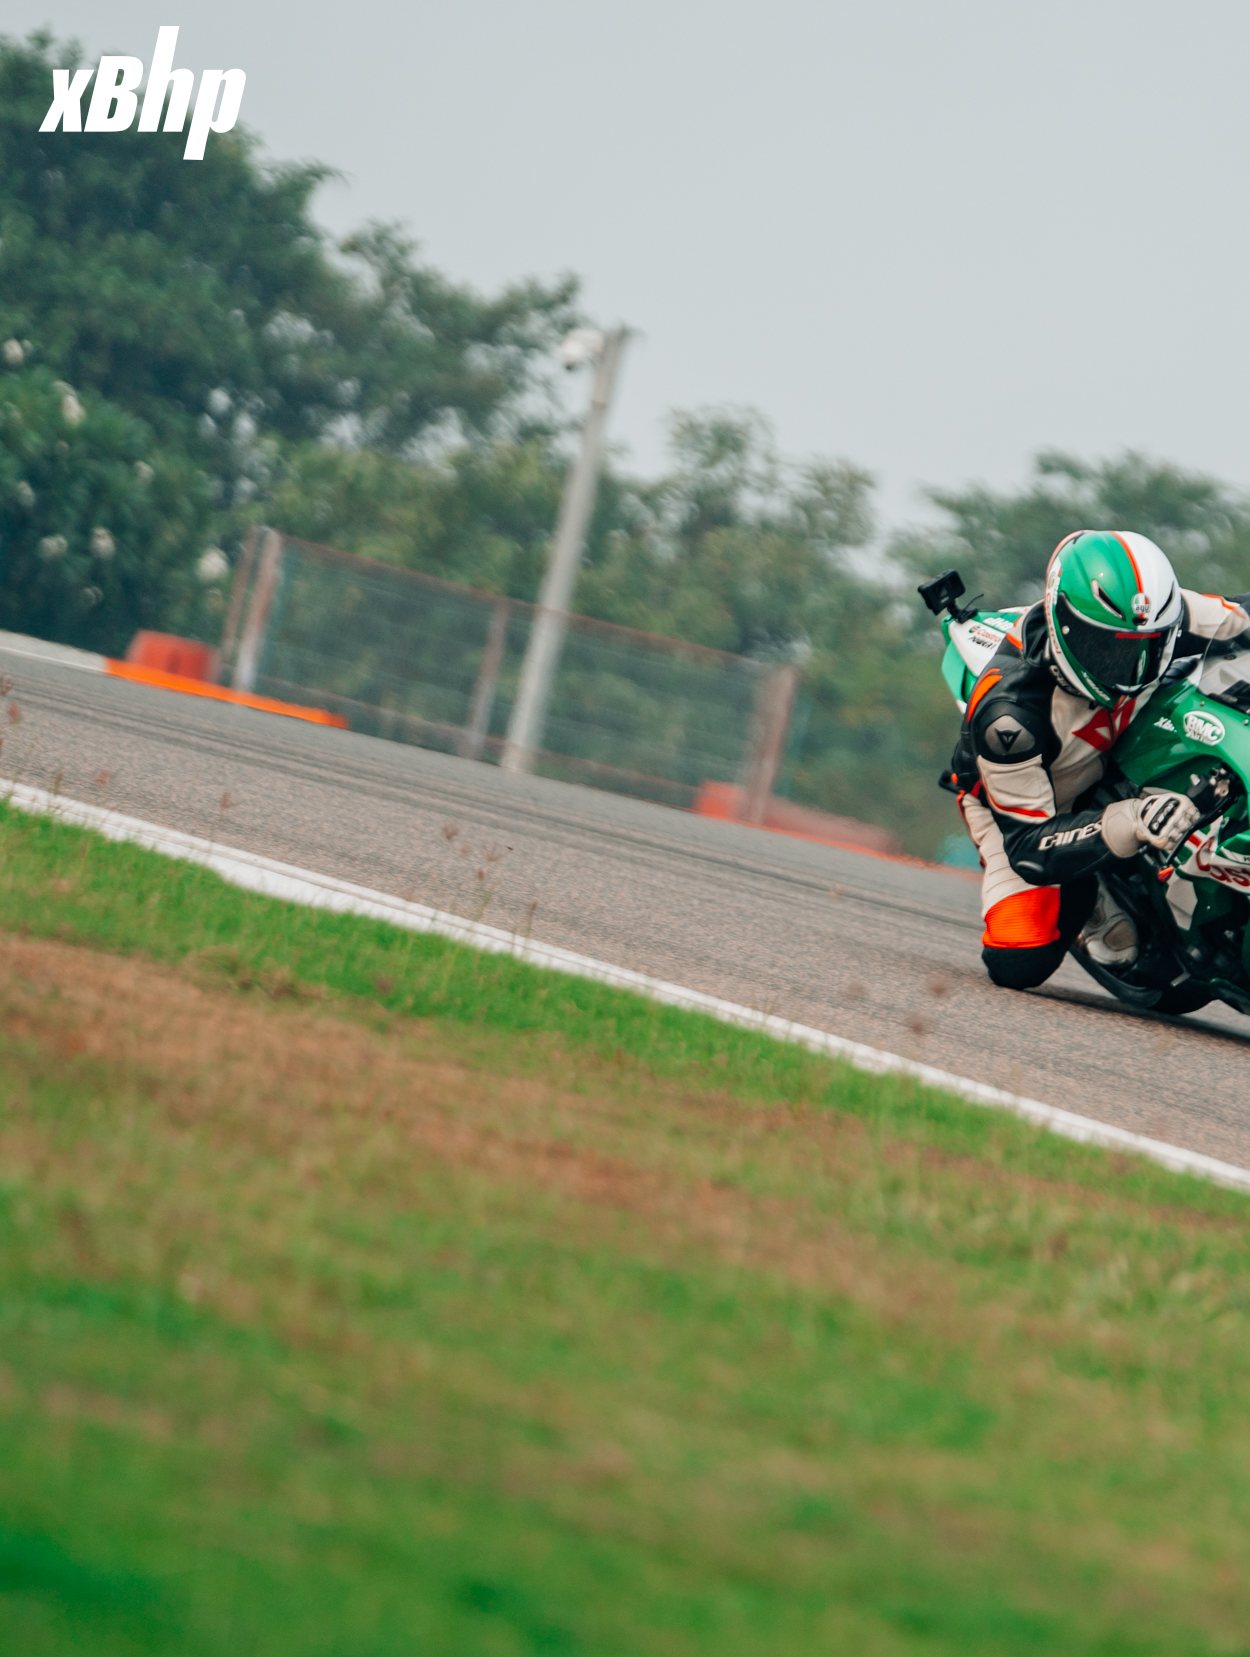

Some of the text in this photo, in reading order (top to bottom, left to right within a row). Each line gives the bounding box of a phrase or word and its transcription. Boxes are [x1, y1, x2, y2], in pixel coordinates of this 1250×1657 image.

[977, 629, 1001, 642] Castro
[1186, 714, 1221, 740] BMC
[1038, 819, 1102, 850] DAINES
